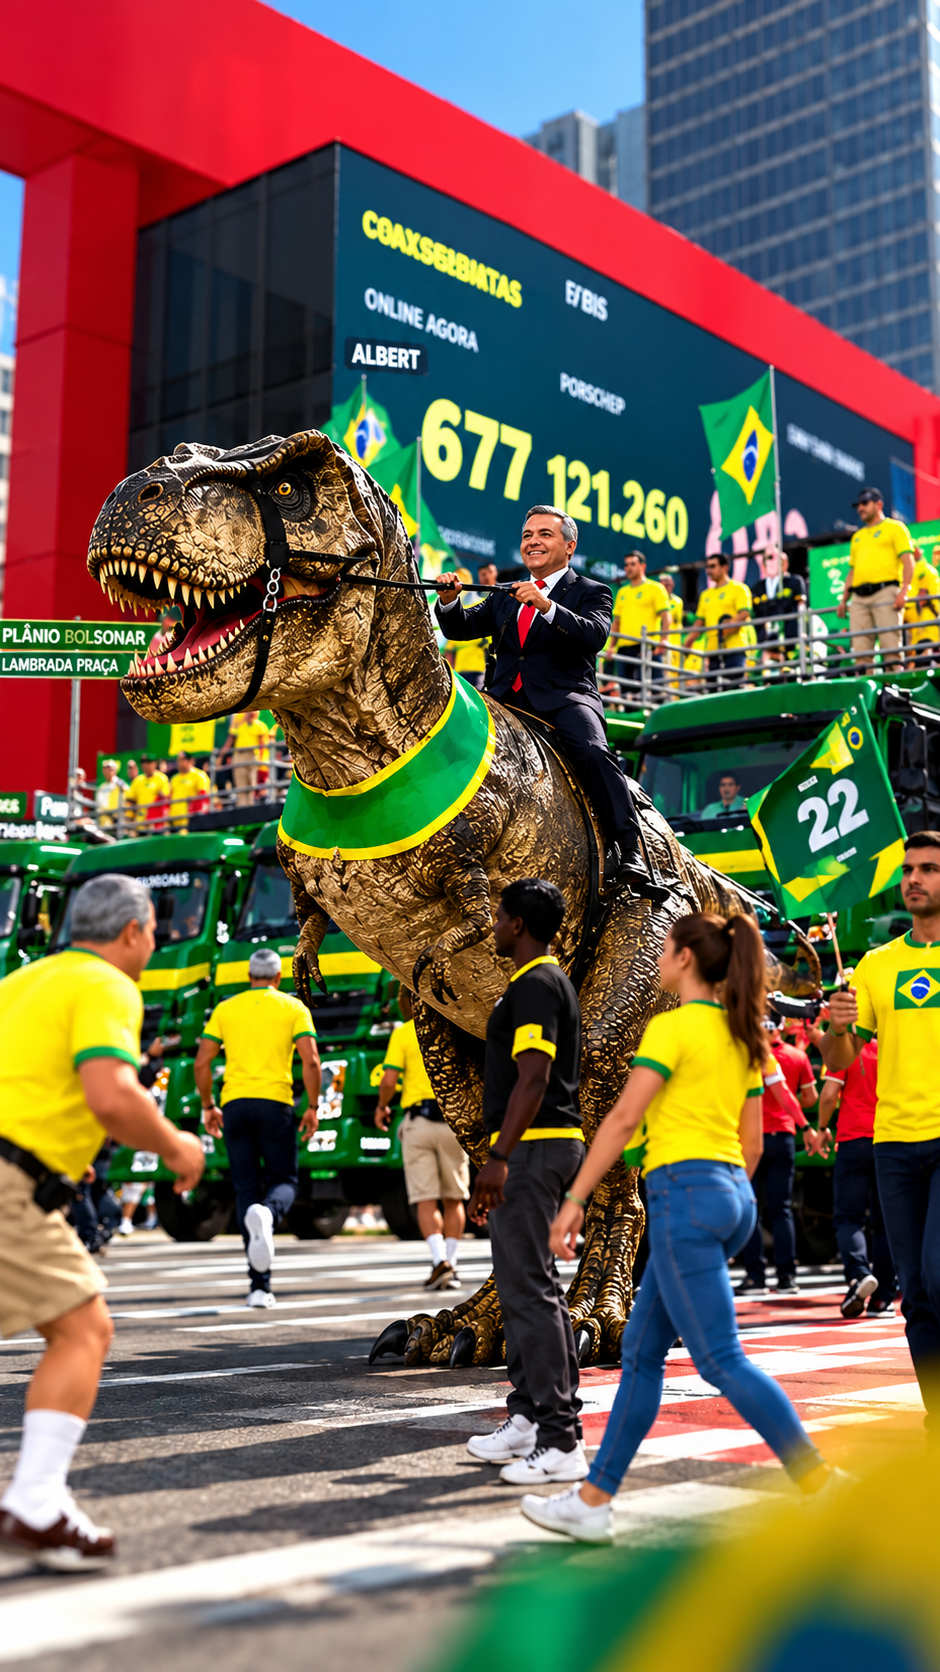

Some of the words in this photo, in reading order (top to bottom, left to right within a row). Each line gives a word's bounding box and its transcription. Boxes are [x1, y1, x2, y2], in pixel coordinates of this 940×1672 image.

[364, 287, 424, 330] ONLINE
[425, 313, 479, 353] AGORA
[351, 343, 421, 370] ALBERT
[421, 398, 532, 501] 677
[547, 454, 688, 550] 121.260
[2, 623, 60, 644] PLÂNIO
[65, 629, 146, 646] BOLSONAR
[2, 657, 73, 672] LAMBRADA
[76, 658, 118, 676] PRAÇA
[797, 778, 870, 853] 22
